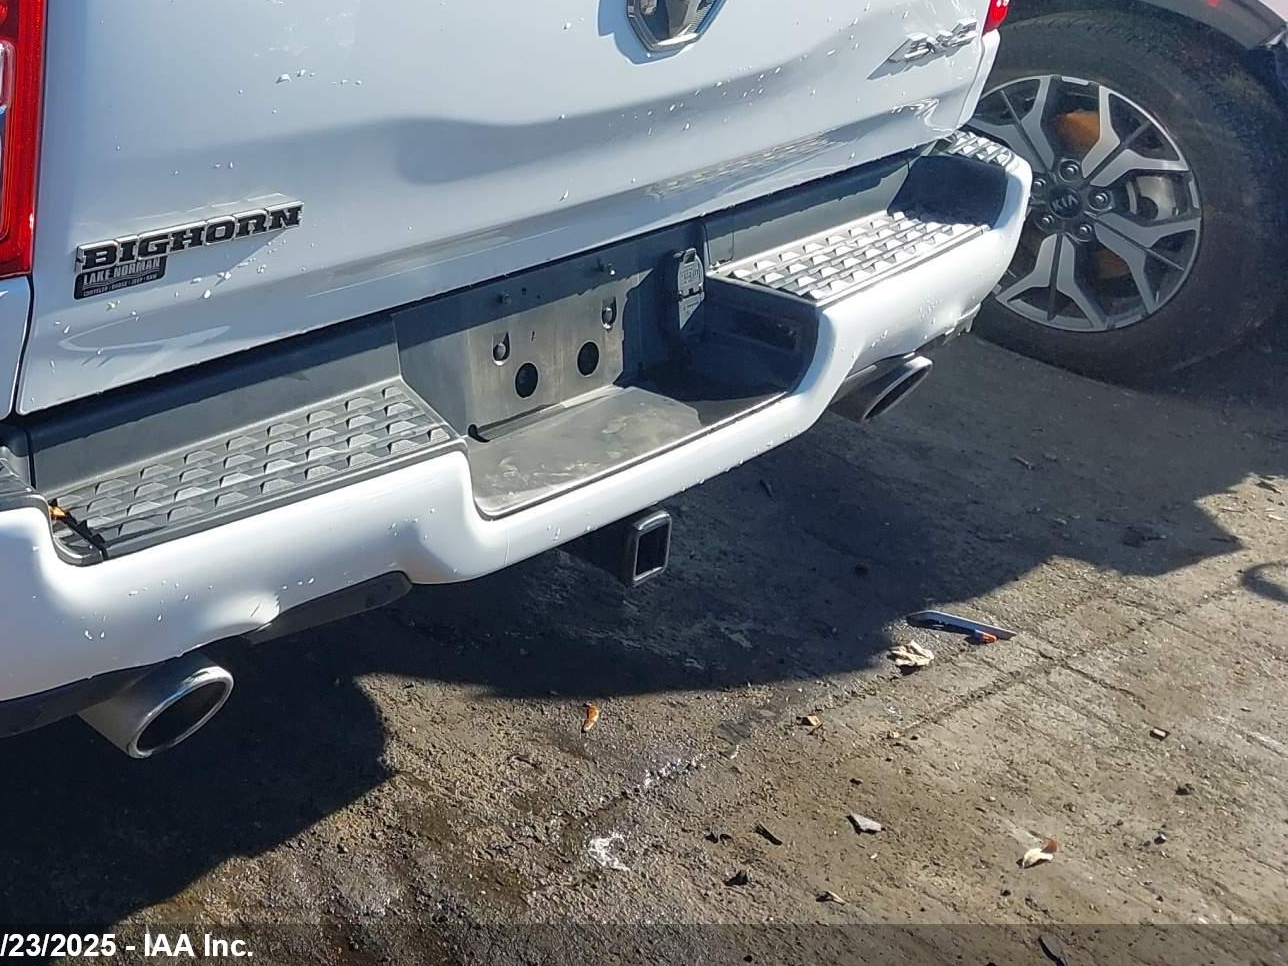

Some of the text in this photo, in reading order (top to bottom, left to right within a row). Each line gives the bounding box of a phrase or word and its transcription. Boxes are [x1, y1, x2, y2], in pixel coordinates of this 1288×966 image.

[1051, 194, 1079, 211] KIA
[78, 202, 304, 271] BIGHORN
[83, 256, 161, 286] LAKE NORMAN
